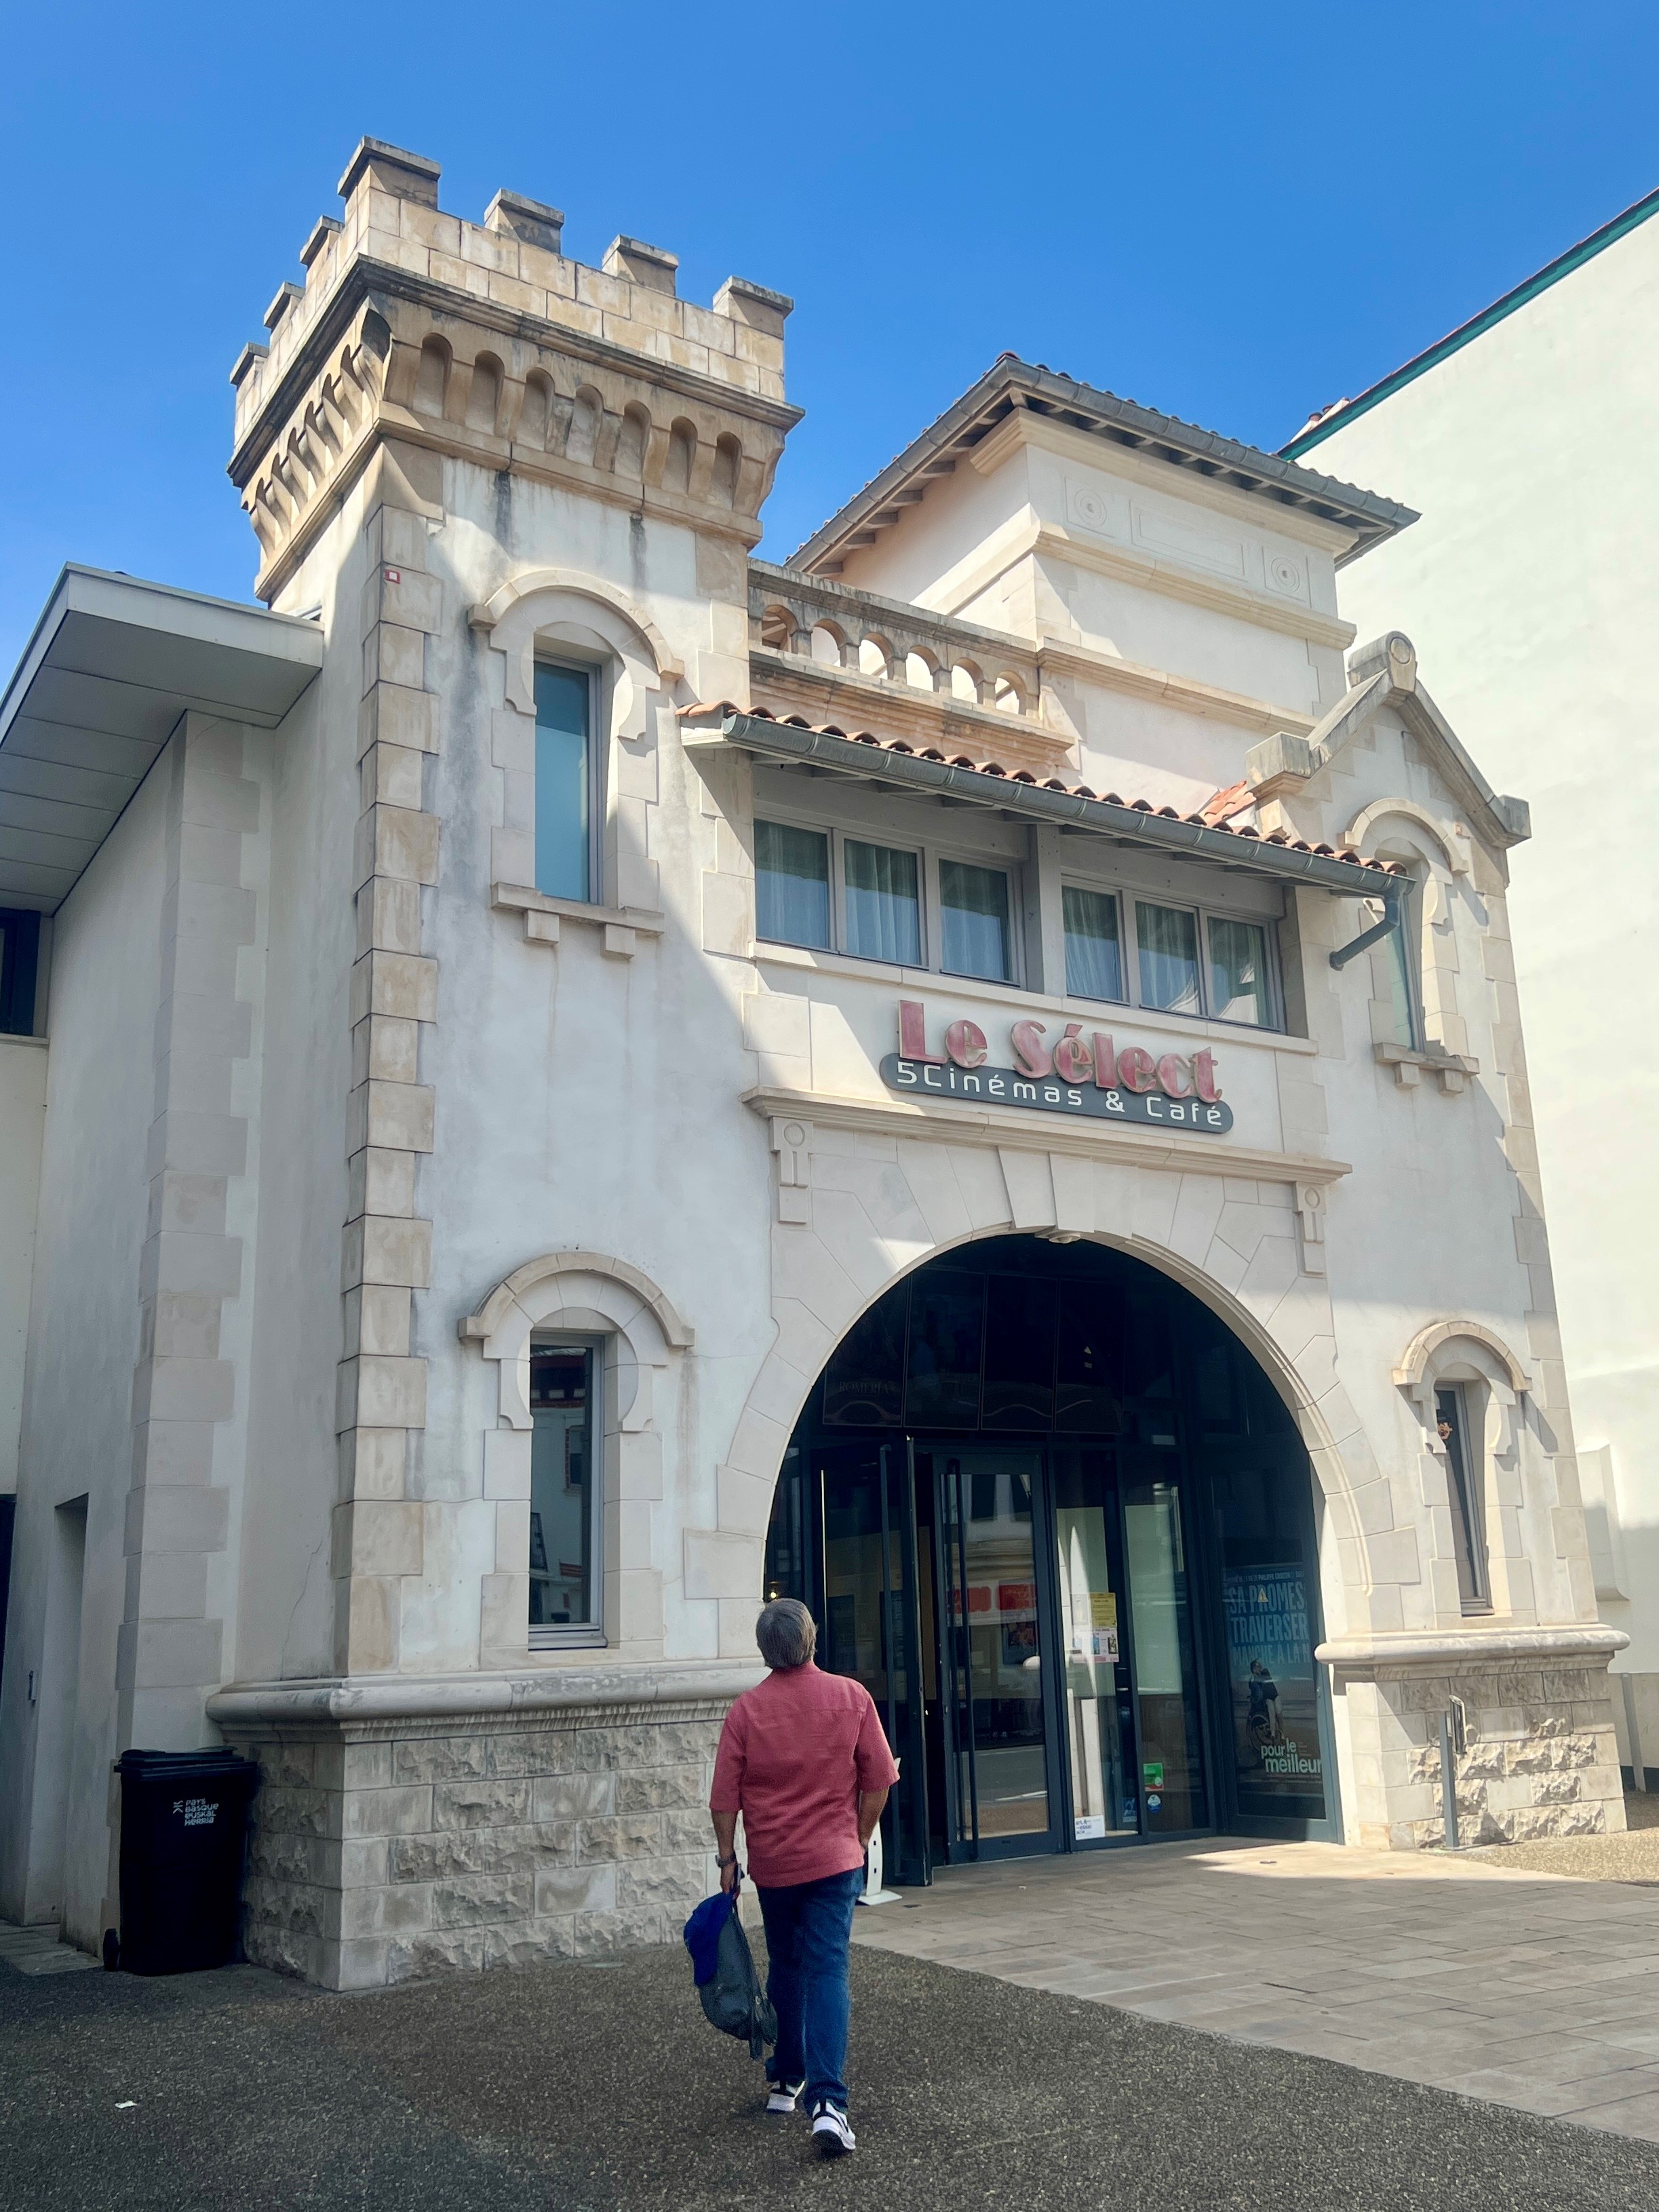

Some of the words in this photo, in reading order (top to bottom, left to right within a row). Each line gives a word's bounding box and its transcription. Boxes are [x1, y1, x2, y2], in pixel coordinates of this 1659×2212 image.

[897, 999, 988, 1068] Le
[1011, 1020, 1223, 1104] Sélect
[1105, 1091, 1125, 1113] &
[1146, 1095, 1223, 1126] Café
[1230, 1612, 1310, 1643] TRAVERSER
[1260, 1744, 1285, 1759] pour
[1286, 1737, 1297, 1753] le
[1265, 1753, 1321, 1773] meilleur
